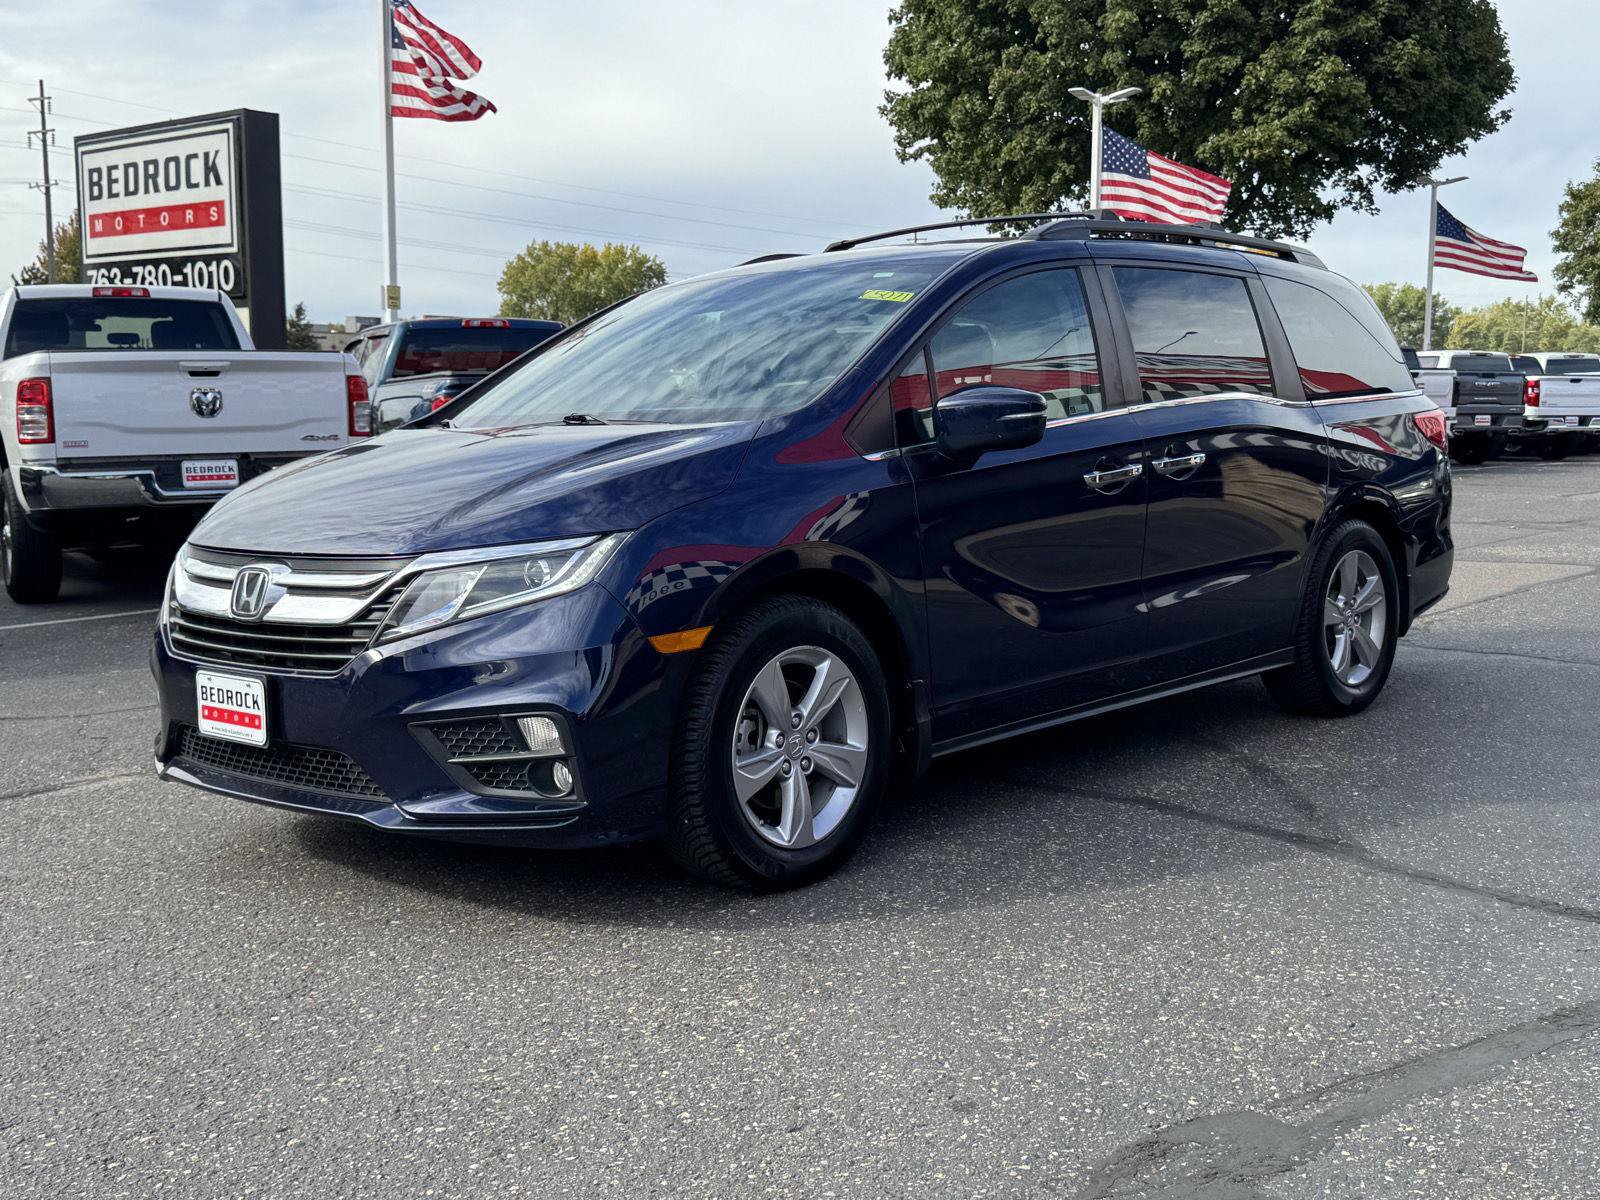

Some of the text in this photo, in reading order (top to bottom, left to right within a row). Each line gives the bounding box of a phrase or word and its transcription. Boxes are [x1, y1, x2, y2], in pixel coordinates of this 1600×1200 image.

[88, 149, 223, 201] BEDROCK
[94, 206, 218, 232] MOTORS
[86, 259, 235, 291] 763-780-1010
[185, 465, 235, 474] BEDROCK
[200, 685, 260, 710] BEDROCK
[203, 709, 259, 726] MOTORS
